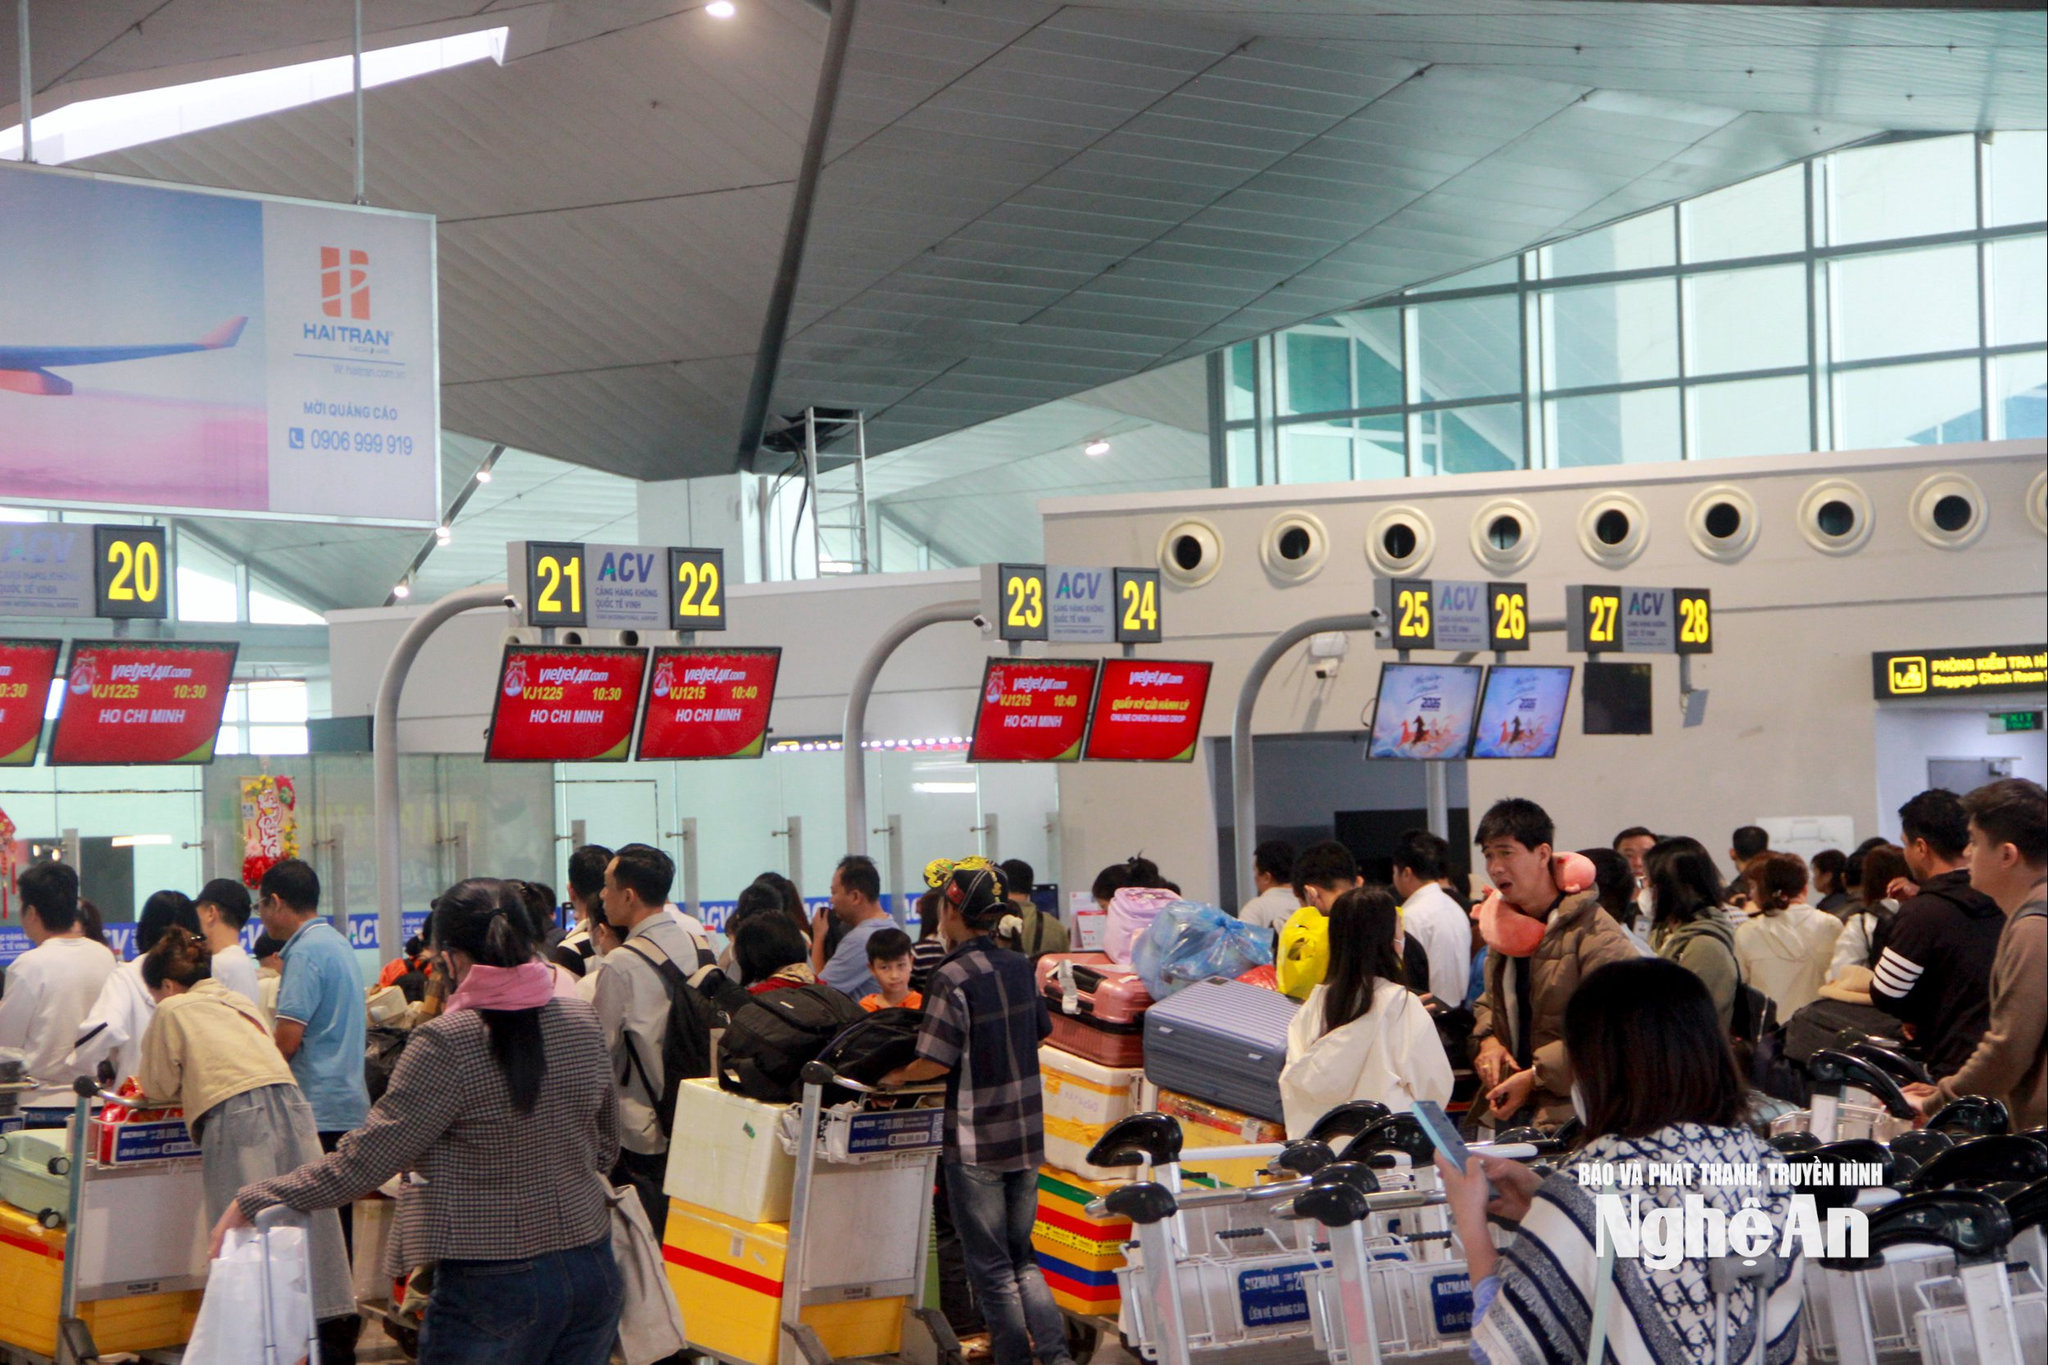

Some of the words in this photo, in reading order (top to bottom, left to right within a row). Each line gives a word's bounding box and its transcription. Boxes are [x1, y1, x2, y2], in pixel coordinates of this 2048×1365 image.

[303, 400, 326, 415] MỜI
[328, 402, 371, 419] QUẢNG
[373, 404, 398, 421] CÁO
[311, 428, 350, 452] 0906
[353, 431, 383, 453] 999
[386, 434, 413, 456] 919
[107, 540, 160, 603] 20
[597, 551, 655, 583] ACV
[537, 555, 581, 613] 21
[678, 561, 720, 617] 22
[1055, 572, 1102, 600] ACV
[1440, 585, 1479, 611] ACV
[1007, 576, 1043, 628] 23
[1122, 580, 1157, 630] 24
[1398, 590, 1430, 638] 25
[1628, 592, 1664, 616] ACV
[1494, 593, 1526, 640] 26
[1589, 595, 1619, 642] 27
[1680, 598, 1709, 643] 28
[2007, 655, 2034, 669] TRA
[91, 684, 140, 698] VJ1225
[172, 685, 207, 699] 10:30
[522, 686, 564, 700] VJ1225
[592, 687, 622, 701] 10:30
[669, 686, 706, 700] VJ1215
[731, 686, 758, 699] 10:40
[99, 709, 121, 723] HO
[123, 709, 147, 723] CHI
[149, 709, 186, 723] MINH
[529, 709, 549, 723] HO
[550, 709, 572, 723] CHI
[573, 709, 605, 723] MINH
[675, 708, 692, 722] HO
[693, 708, 713, 722] CHI
[714, 708, 742, 722] MINH
[1003, 714, 1020, 728] HO
[1020, 714, 1038, 728] CHI
[1037, 714, 1063, 728] MINH
